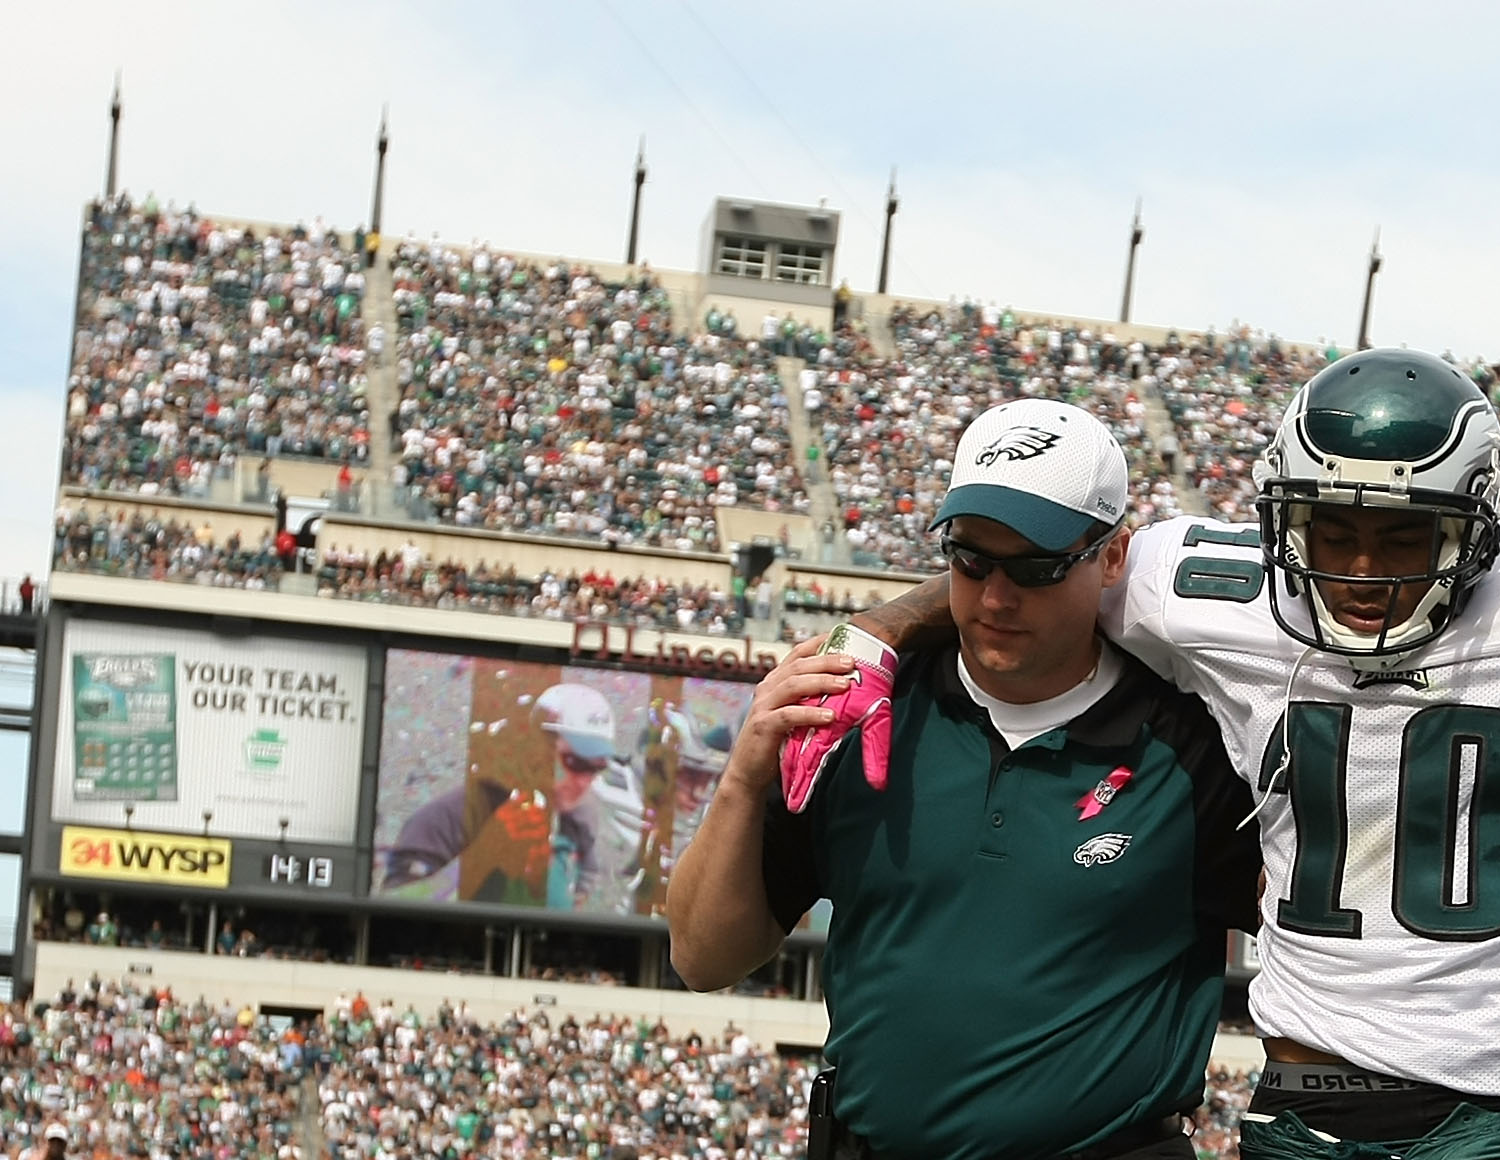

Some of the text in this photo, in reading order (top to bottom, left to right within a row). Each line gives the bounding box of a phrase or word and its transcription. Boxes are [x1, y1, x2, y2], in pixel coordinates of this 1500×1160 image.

[1173, 524, 1264, 604] 10
[183, 662, 347, 696] YOUR TEAM.
[193, 689, 248, 712] OUR
[256, 695, 357, 723] TICKET.
[118, 842, 225, 874] WYSP
